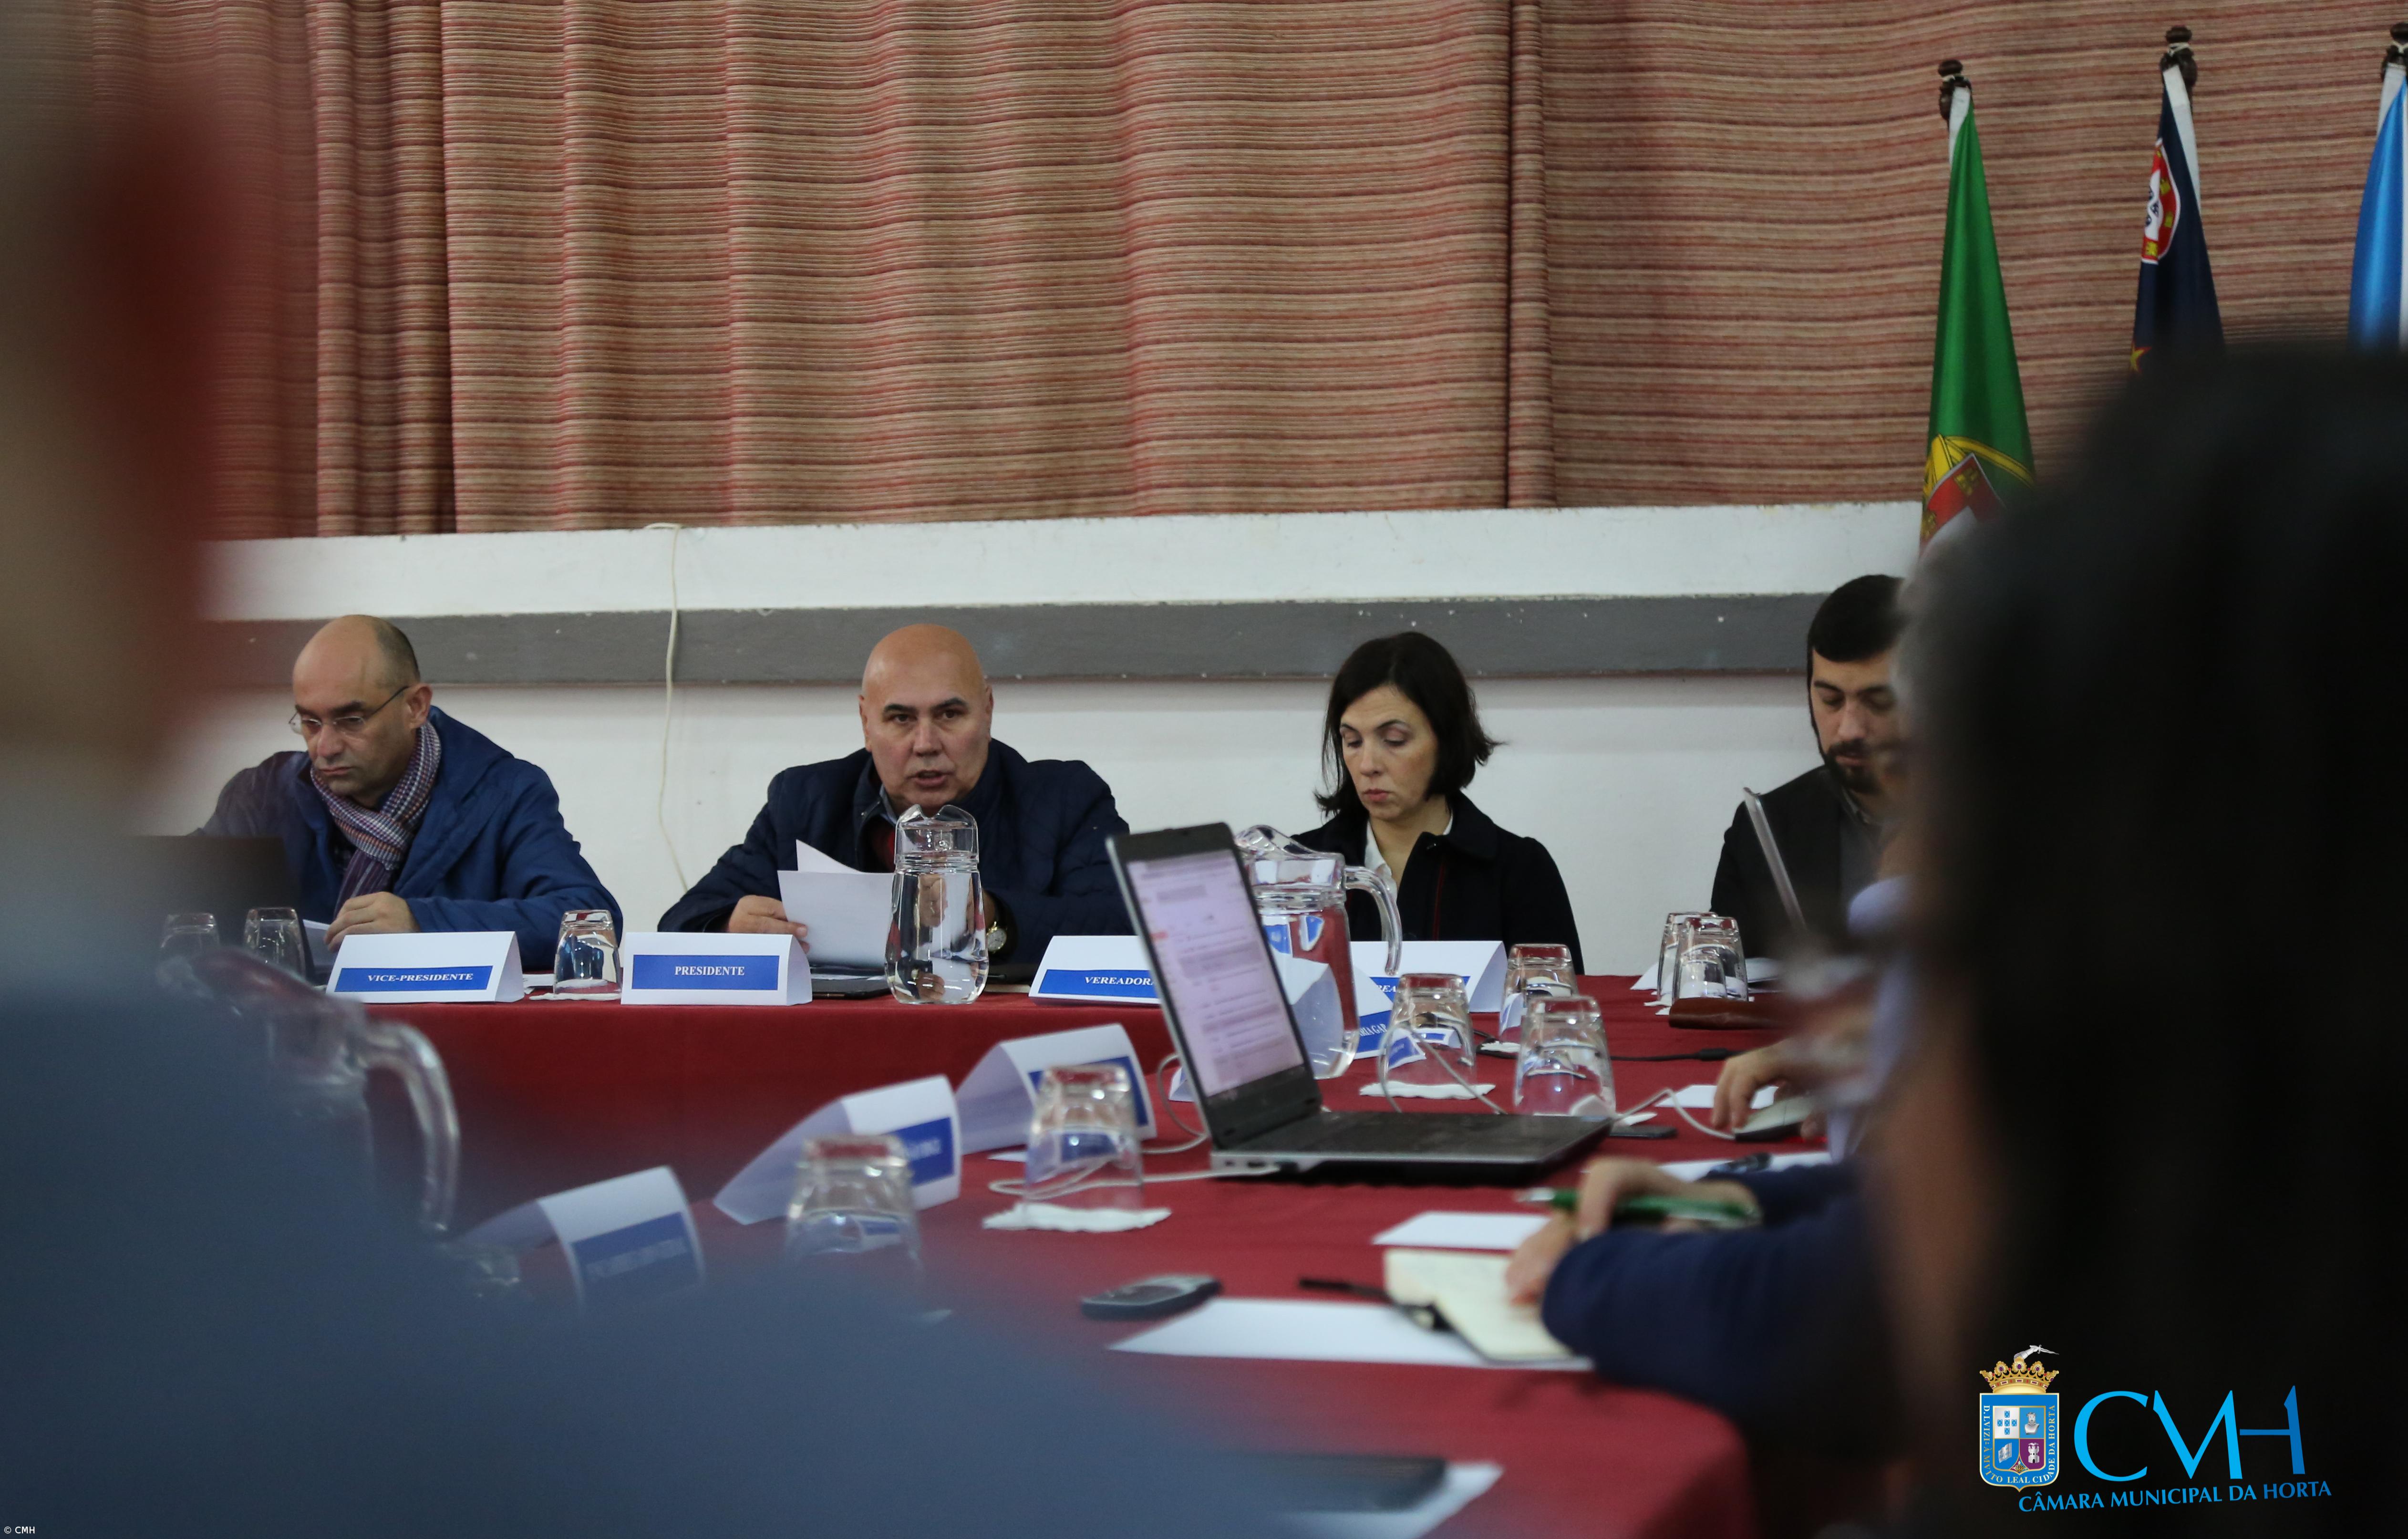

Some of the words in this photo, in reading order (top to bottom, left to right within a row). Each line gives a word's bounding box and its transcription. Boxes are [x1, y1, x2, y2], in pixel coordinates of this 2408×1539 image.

[675, 966, 744, 976] PRESIDENTE
[368, 973, 473, 981] VICE-PRESIDENTE
[1085, 977, 1154, 986] VEREADOR
